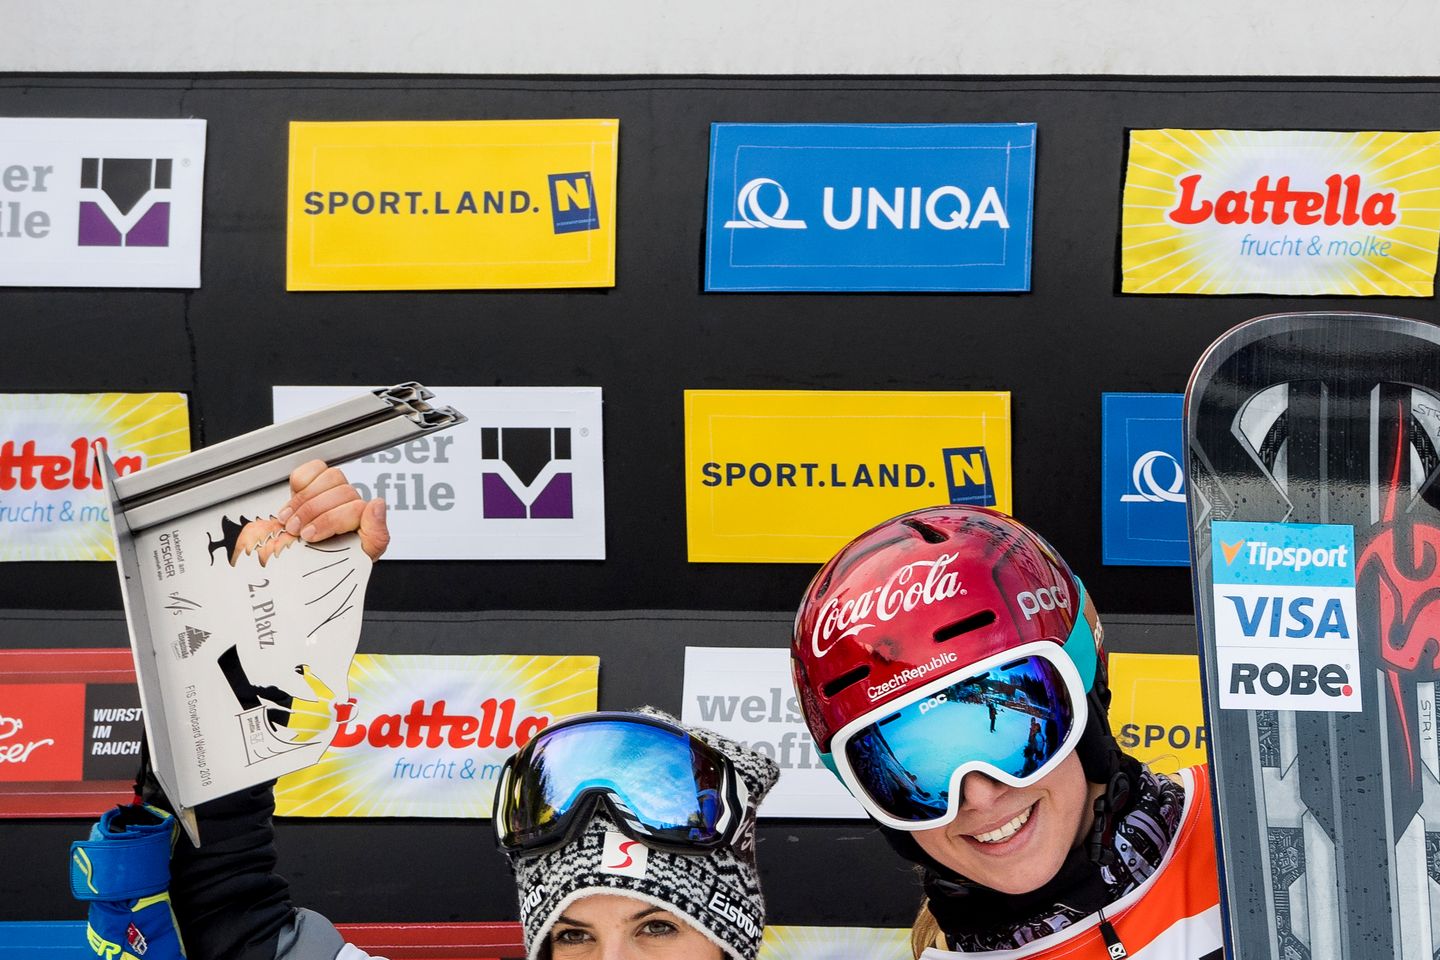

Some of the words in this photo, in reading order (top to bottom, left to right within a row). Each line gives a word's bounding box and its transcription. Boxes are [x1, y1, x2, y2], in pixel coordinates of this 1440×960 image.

[303, 189, 540, 216] SPORT.LAND.
[822, 185, 1010, 232] UNIQA
[1168, 173, 1397, 227] Lattella
[1240, 232, 1303, 258] frucht
[1307, 233, 1323, 257] &
[1326, 232, 1393, 258] molke
[701, 462, 936, 489] SPORT.LAND.
[0, 501, 55, 522] rucht
[1246, 541, 1348, 570] Tipsport
[252, 599, 279, 650] Platz
[1222, 595, 1350, 640] VISA
[92, 707, 143, 722] WURST
[696, 688, 806, 724] wels
[92, 725, 112, 739] IM
[330, 698, 549, 749] Lattella
[91, 741, 141, 756] RAUCH
[392, 757, 457, 780] frucht
[460, 758, 477, 780] &
